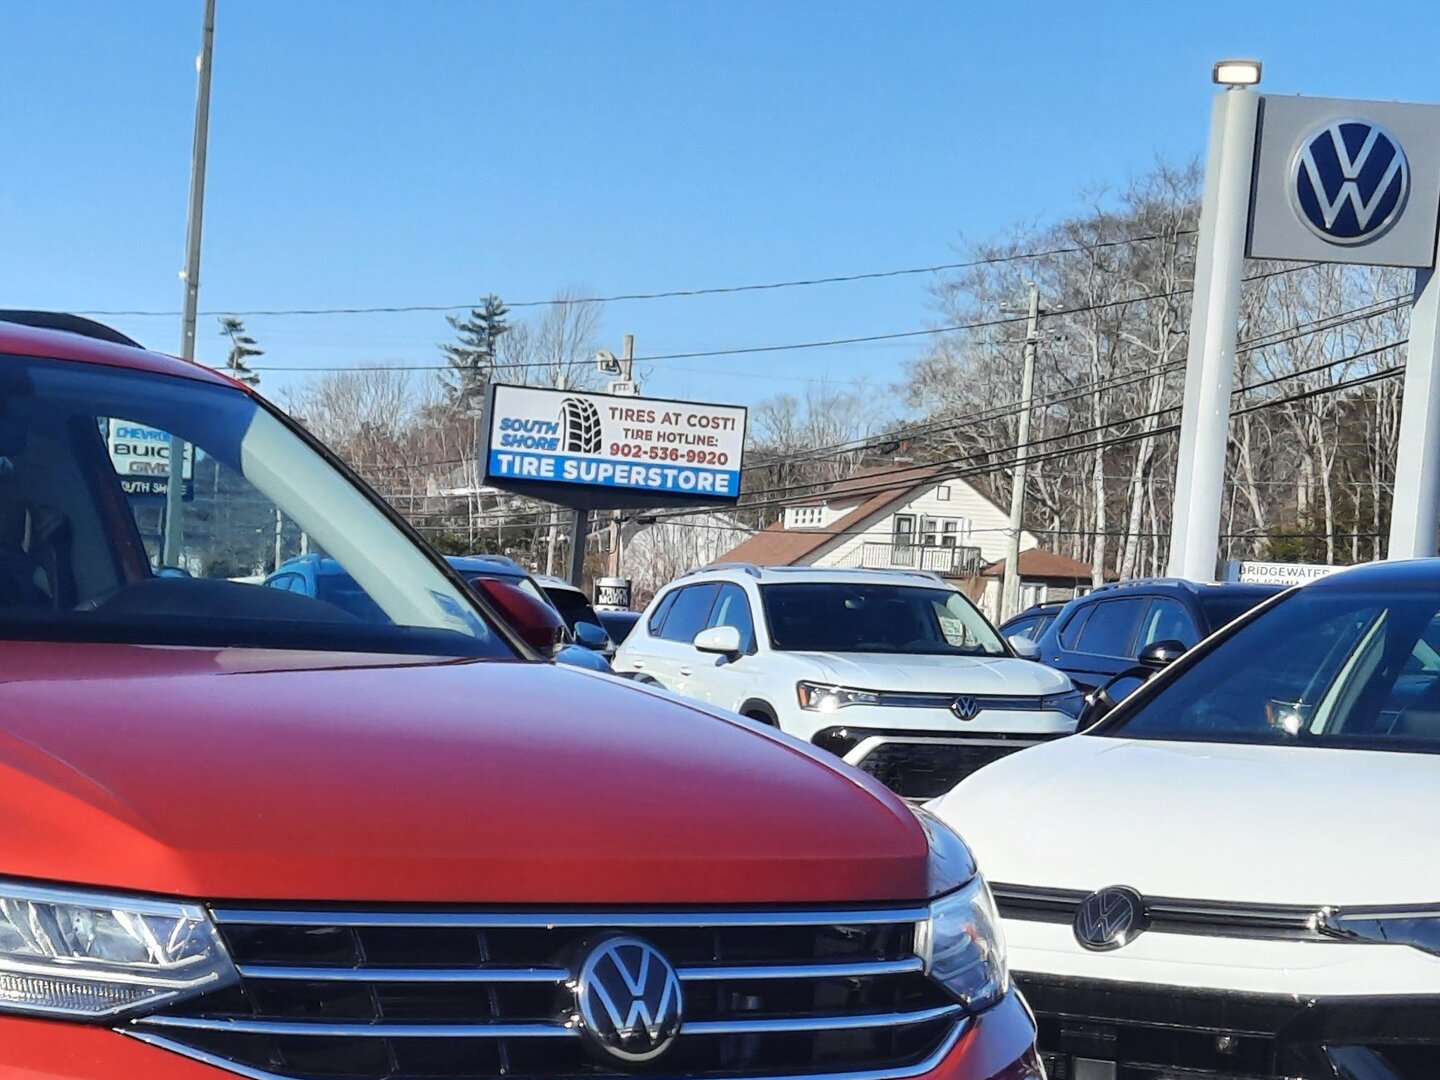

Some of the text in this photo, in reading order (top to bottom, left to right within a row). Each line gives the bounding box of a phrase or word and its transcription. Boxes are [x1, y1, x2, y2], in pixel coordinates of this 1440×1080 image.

[499, 418, 559, 435] SOUTH
[609, 406, 735, 431] TIRES AT COST!
[500, 433, 560, 451] SHORE
[623, 428, 718, 447] TIRE HOTLINE:
[610, 443, 728, 466] 902-536-9920
[497, 454, 730, 493] TIRE SUPERSTORE
[120, 480, 187, 496] OUTH SHE
